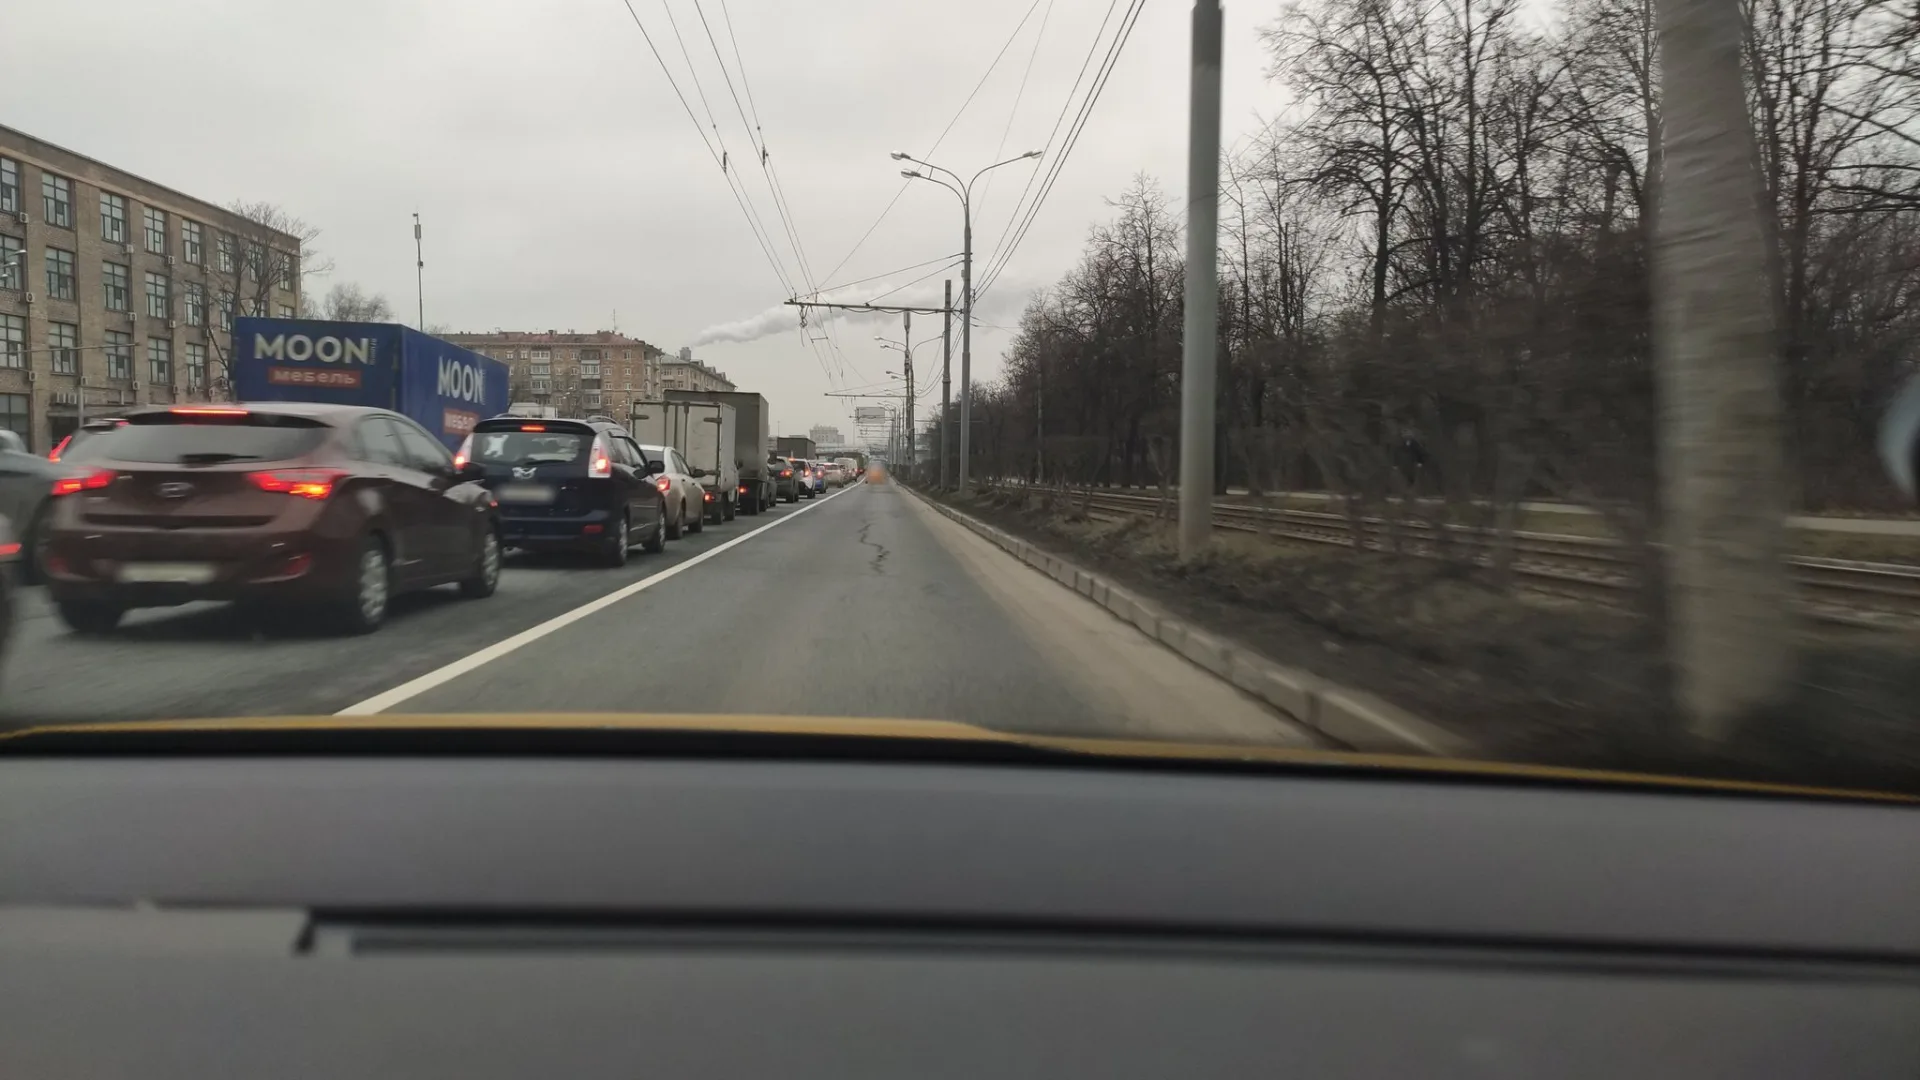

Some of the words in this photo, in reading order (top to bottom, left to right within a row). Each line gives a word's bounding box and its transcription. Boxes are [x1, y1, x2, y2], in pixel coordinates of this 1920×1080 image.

[254, 333, 369, 364] MOON
[273, 370, 356, 384] мебель
[438, 356, 483, 404] MOON
